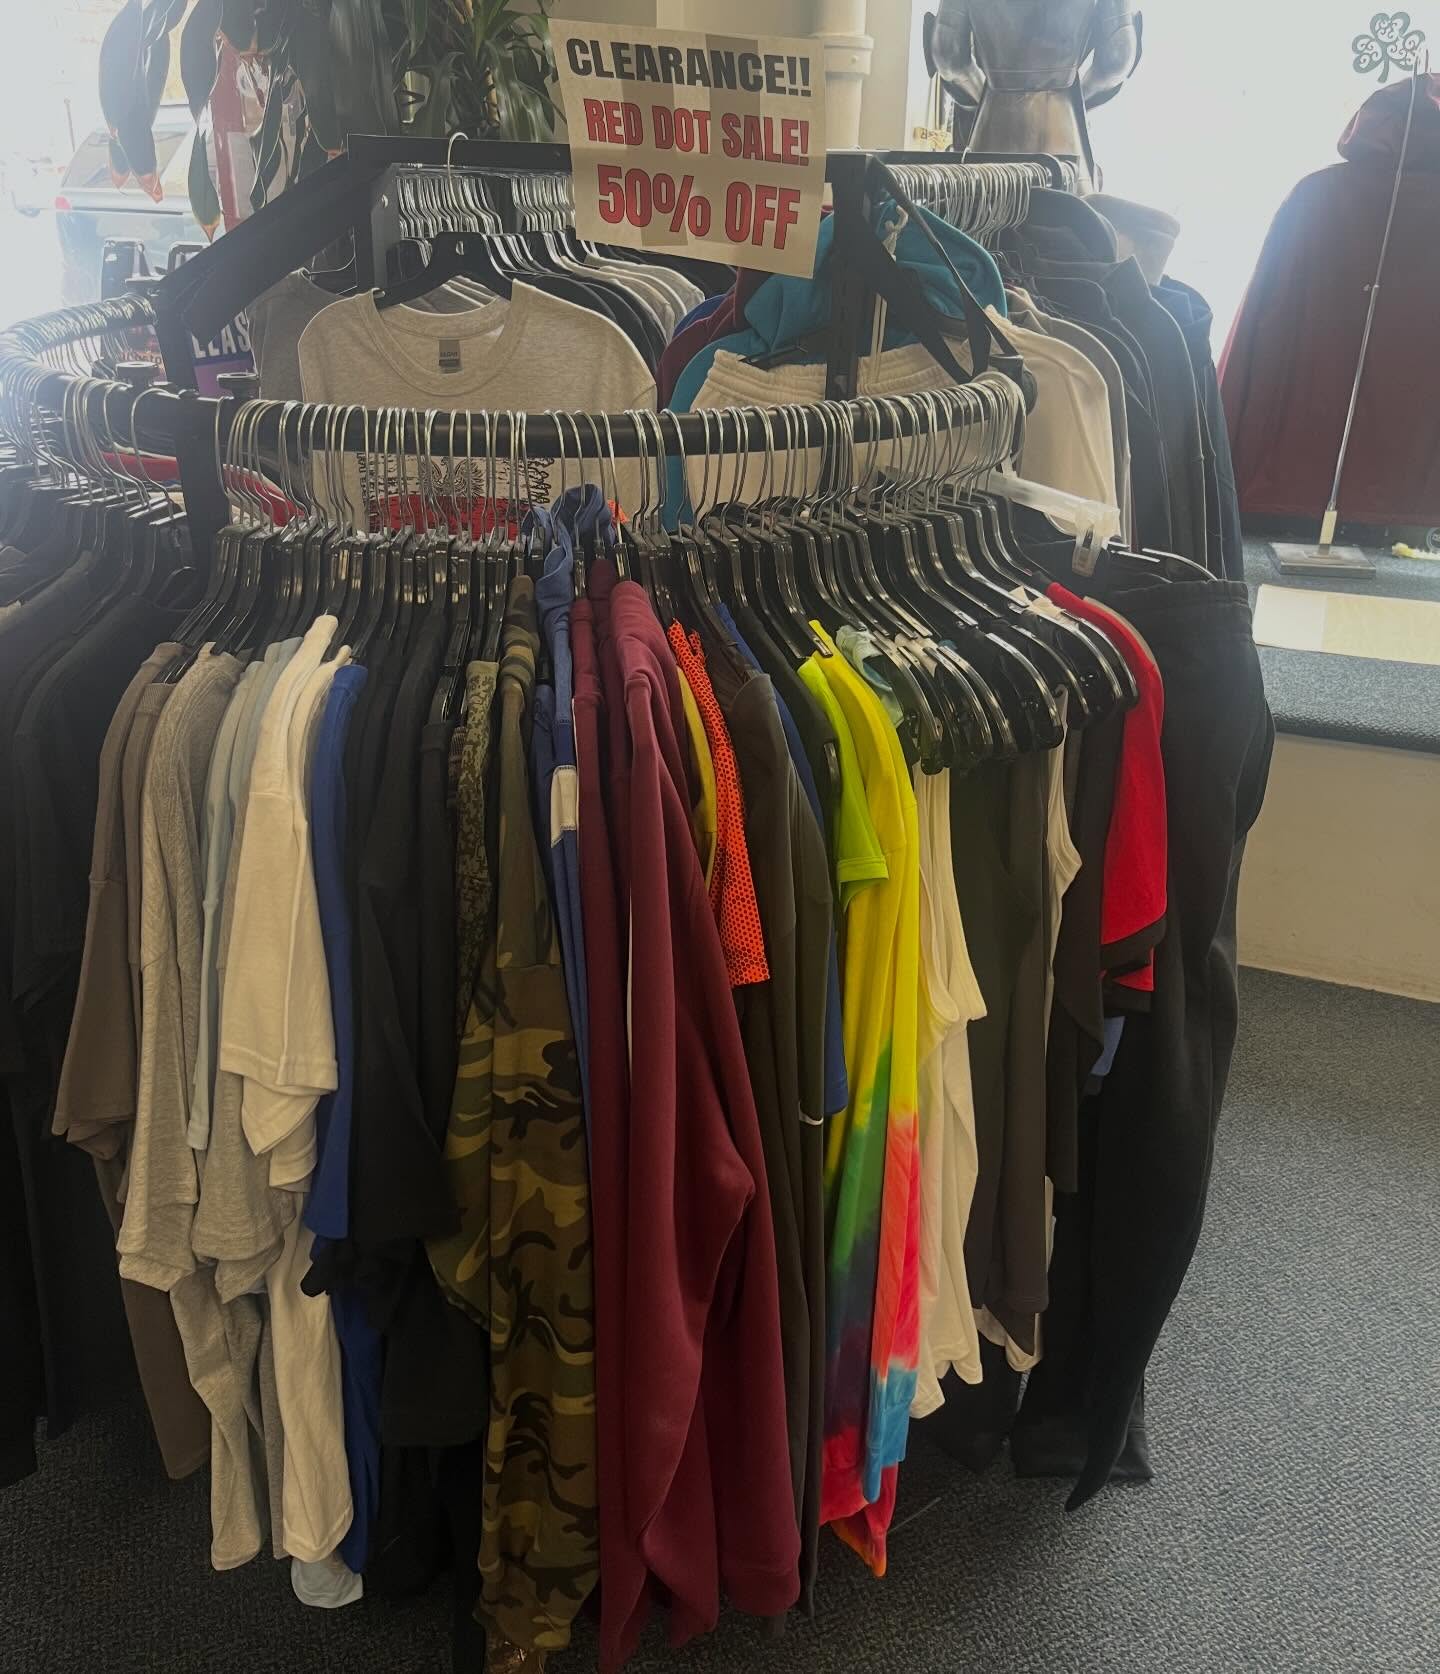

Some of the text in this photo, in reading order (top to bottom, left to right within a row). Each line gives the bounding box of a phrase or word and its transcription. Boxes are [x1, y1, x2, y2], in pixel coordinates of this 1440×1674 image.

[566, 38, 812, 97] CLEARANCE!!
[583, 98, 809, 167] RED DOT SALE!
[597, 164, 801, 250] 50% OFF
